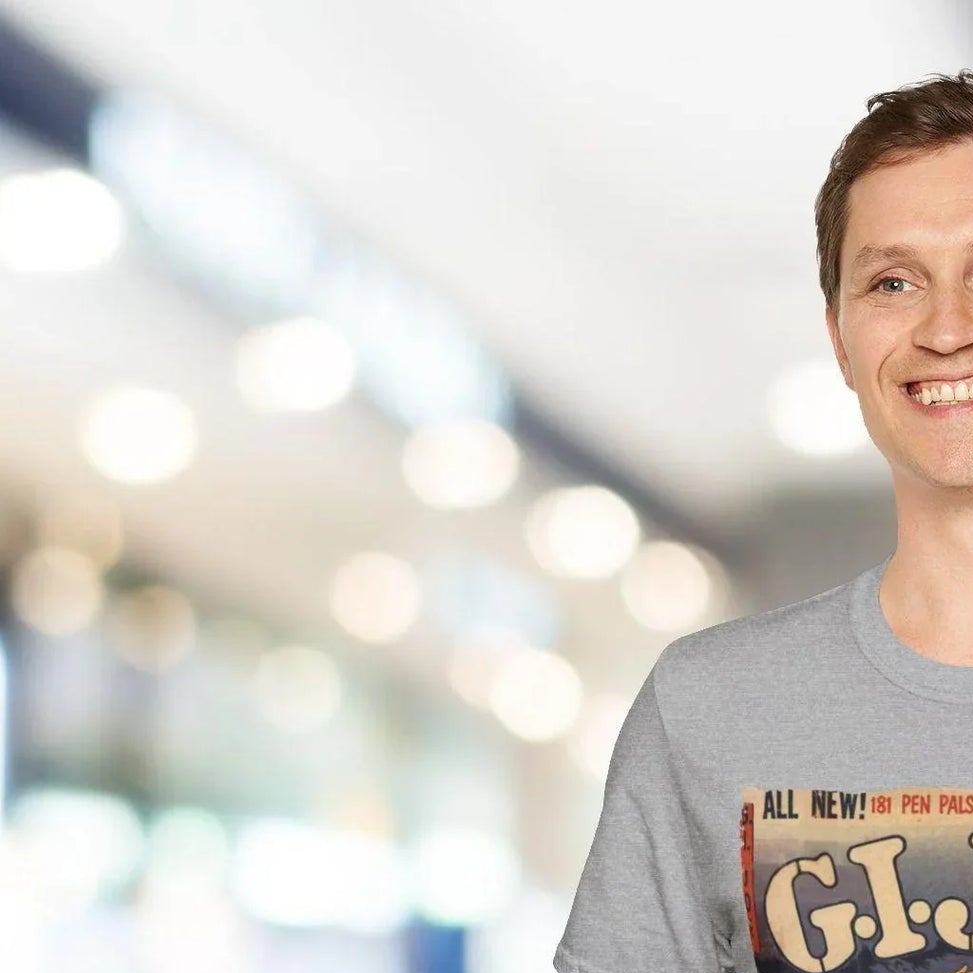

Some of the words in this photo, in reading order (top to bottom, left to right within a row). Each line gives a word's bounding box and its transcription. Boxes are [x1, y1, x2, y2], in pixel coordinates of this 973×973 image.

[763, 790, 799, 819] ALL
[811, 789, 867, 820] NEW!
[870, 795, 892, 815] 181
[901, 793, 932, 815] PEN
